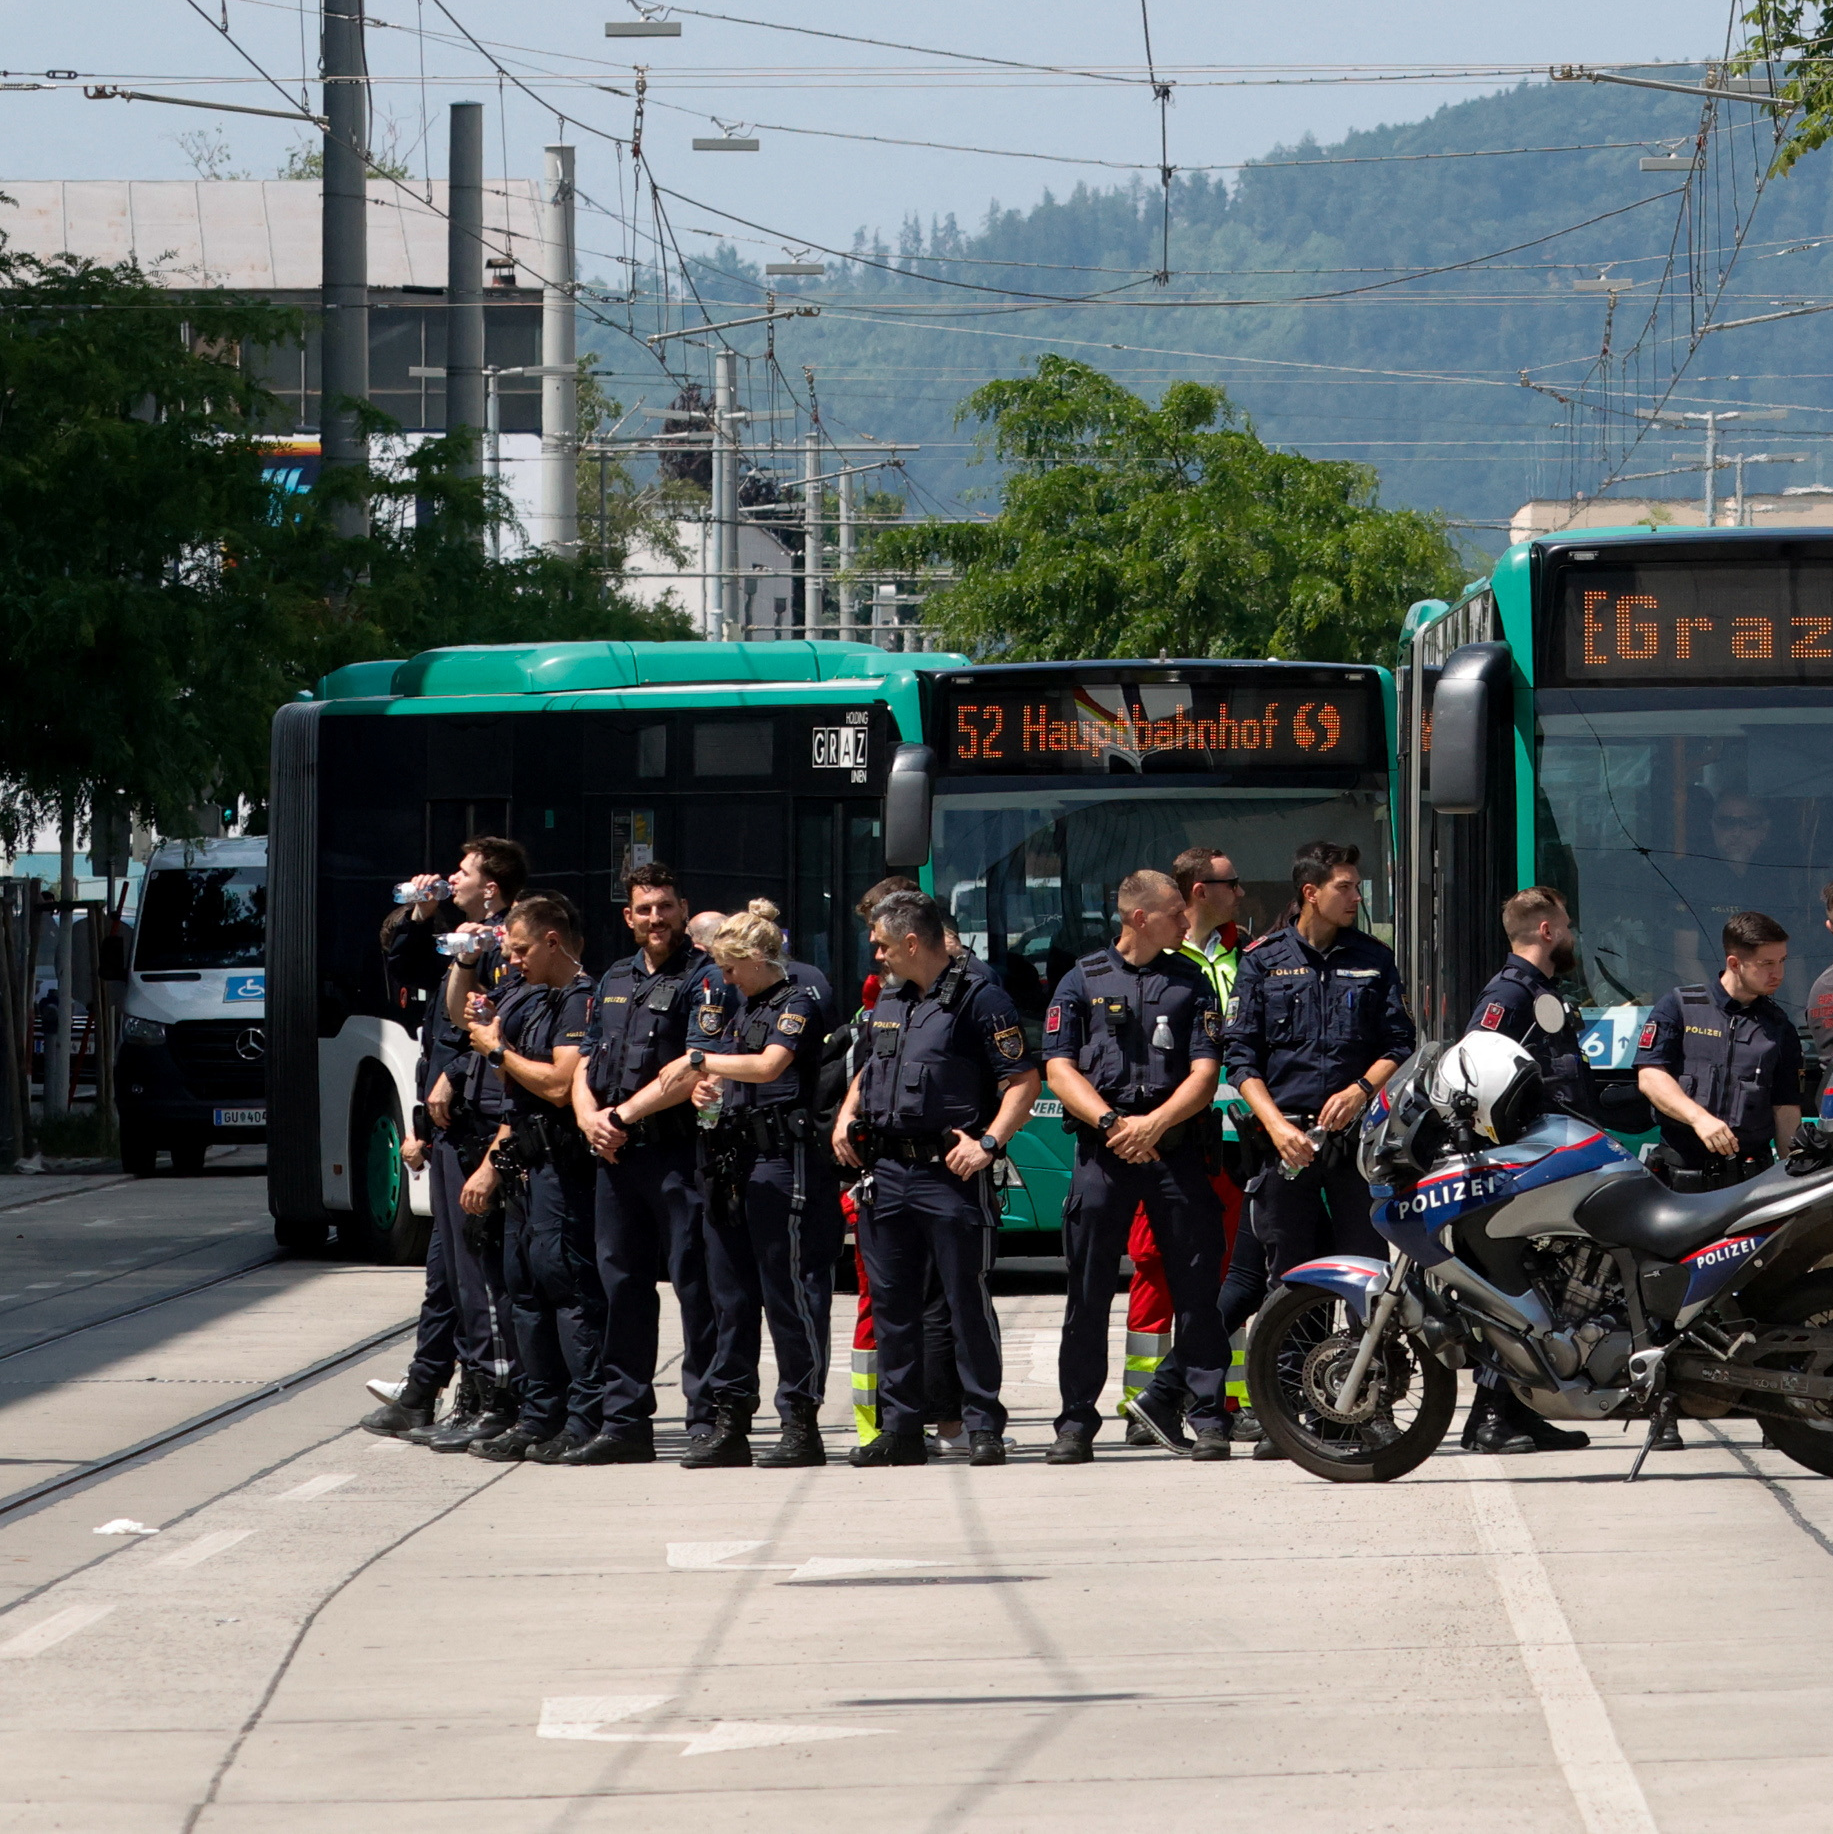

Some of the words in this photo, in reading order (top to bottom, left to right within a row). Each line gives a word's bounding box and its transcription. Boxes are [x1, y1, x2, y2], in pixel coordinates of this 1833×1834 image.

[957, 705, 1003, 759] 52
[1022, 703, 1279, 758] Hauptbahnhof
[813, 731, 866, 764] GRAZ
[1269, 967, 1309, 977] POLIZEI
[1685, 1025, 1722, 1038] POLIZEI
[1399, 1176, 1495, 1220] POLIZEI
[1696, 1238, 1756, 1269] POLIZEI
